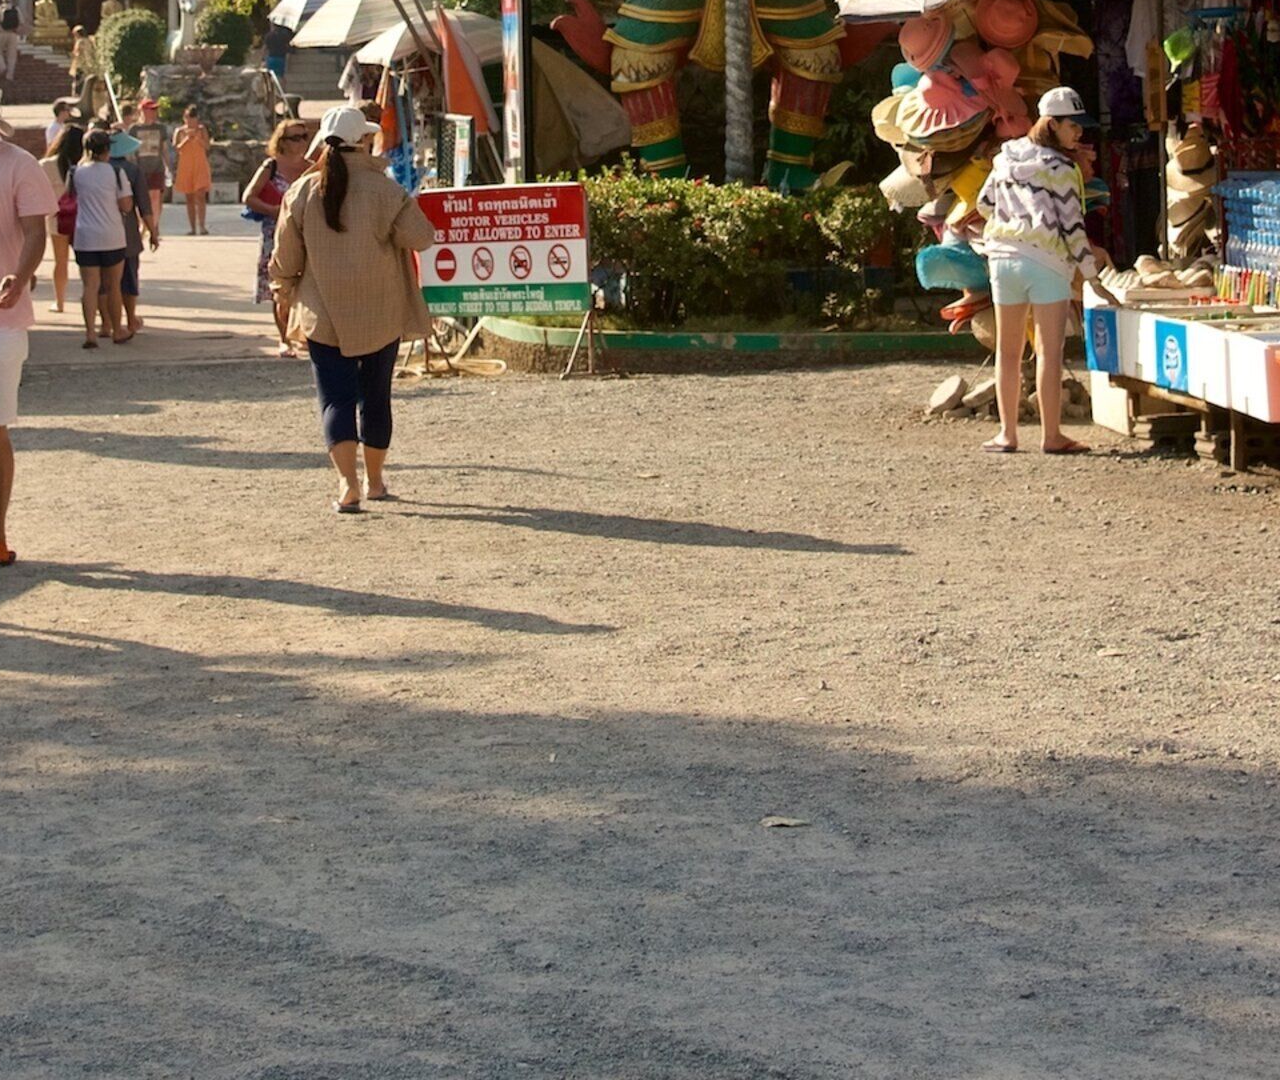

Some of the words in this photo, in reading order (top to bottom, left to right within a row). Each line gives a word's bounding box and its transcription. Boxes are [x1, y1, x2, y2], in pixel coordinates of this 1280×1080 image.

[443, 194, 473, 213] ห้าม!
[478, 193, 558, 215] รถทุกชนิดเข้า
[451, 215, 491, 228] MOTOR
[494, 213, 550, 226] VEHICLES
[434, 229, 446, 242] RE
[449, 228, 470, 242] NOT
[472, 227, 522, 241] ALLOWED
[525, 226, 541, 239] TO
[544, 224, 580, 238] ENTER
[458, 301, 483, 313] STREET
[484, 301, 495, 313] TO
[495, 301, 510, 312] THE
[511, 301, 524, 312] BIG
[525, 300, 553, 312] BUDDHA
[554, 300, 582, 311] TEMPLE
